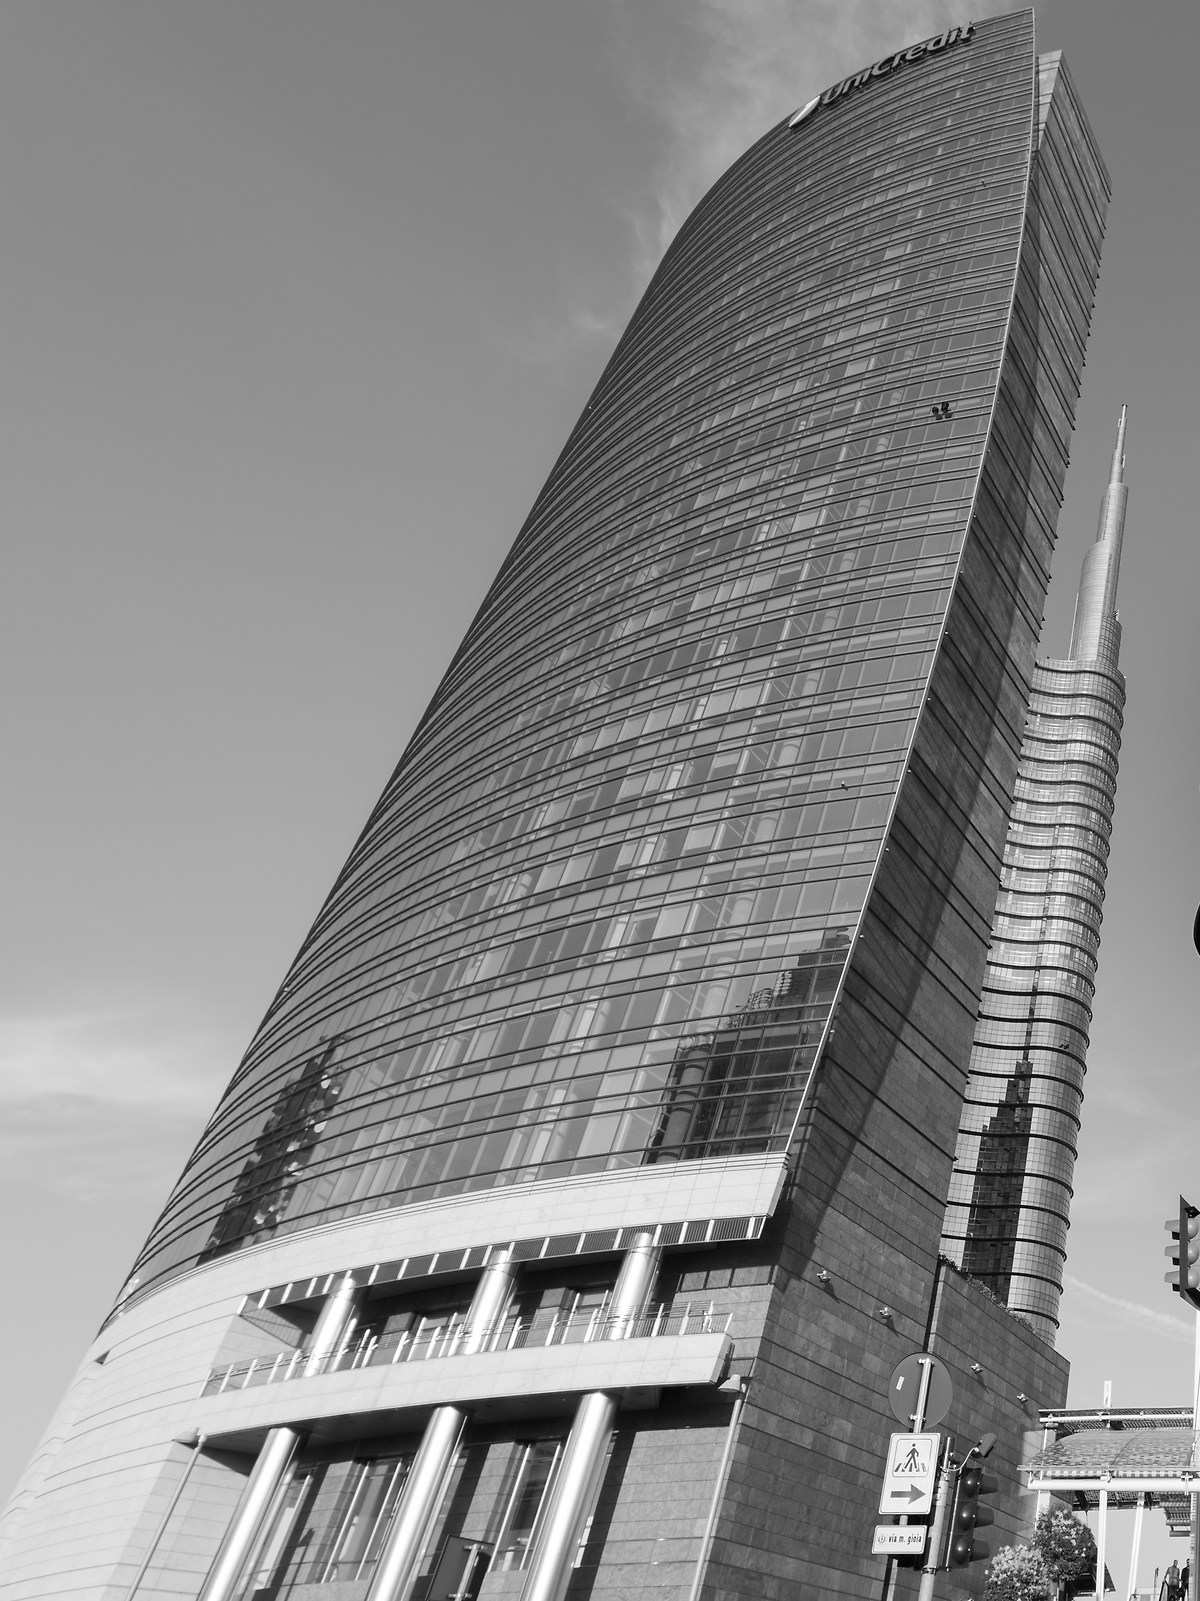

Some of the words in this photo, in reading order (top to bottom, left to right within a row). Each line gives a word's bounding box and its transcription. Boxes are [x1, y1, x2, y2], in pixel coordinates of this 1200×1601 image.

[822, 22, 974, 106] UniCredit
[888, 1533, 897, 1543] via
[898, 1535, 906, 1543] m.
[907, 1533, 922, 1545] gioia
